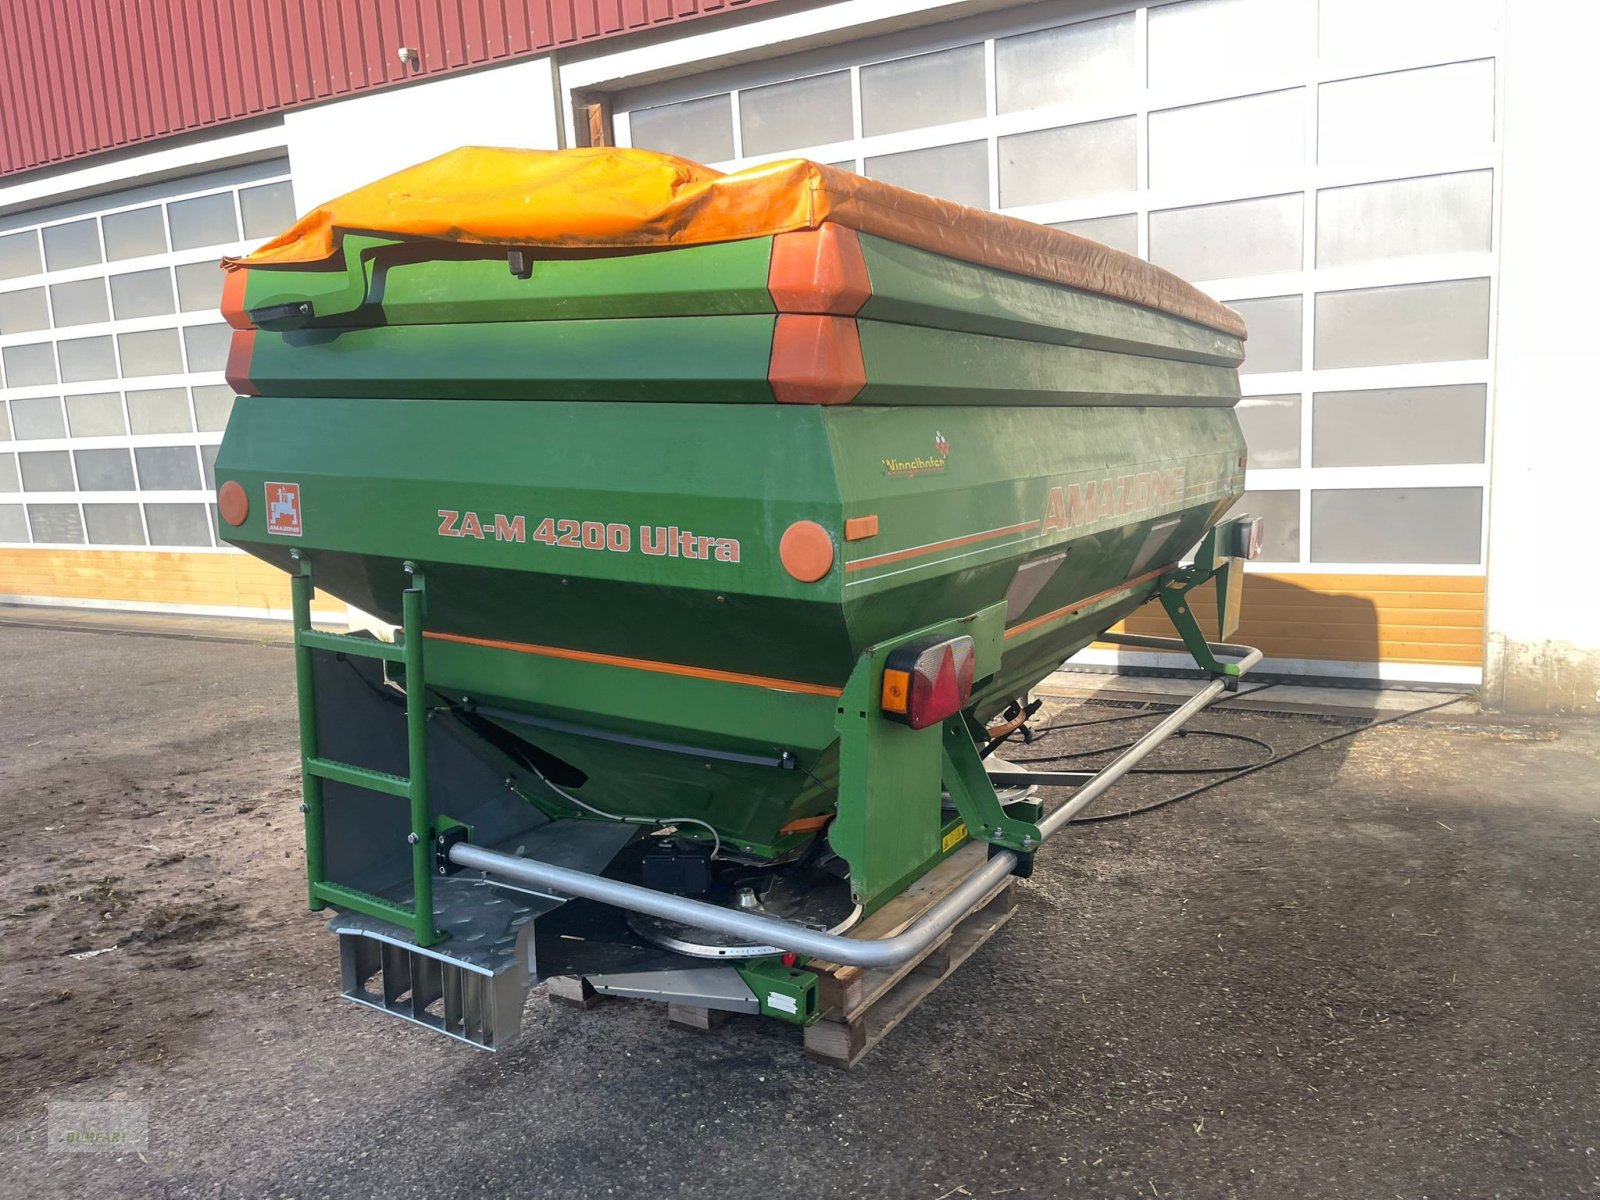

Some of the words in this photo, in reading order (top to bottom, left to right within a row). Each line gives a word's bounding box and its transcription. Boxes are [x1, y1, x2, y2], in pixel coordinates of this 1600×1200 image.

[1040, 466, 1186, 537] AMAZONE
[437, 509, 526, 543] ZA-M
[533, 518, 631, 552] 4200
[640, 525, 741, 563] Ultra
